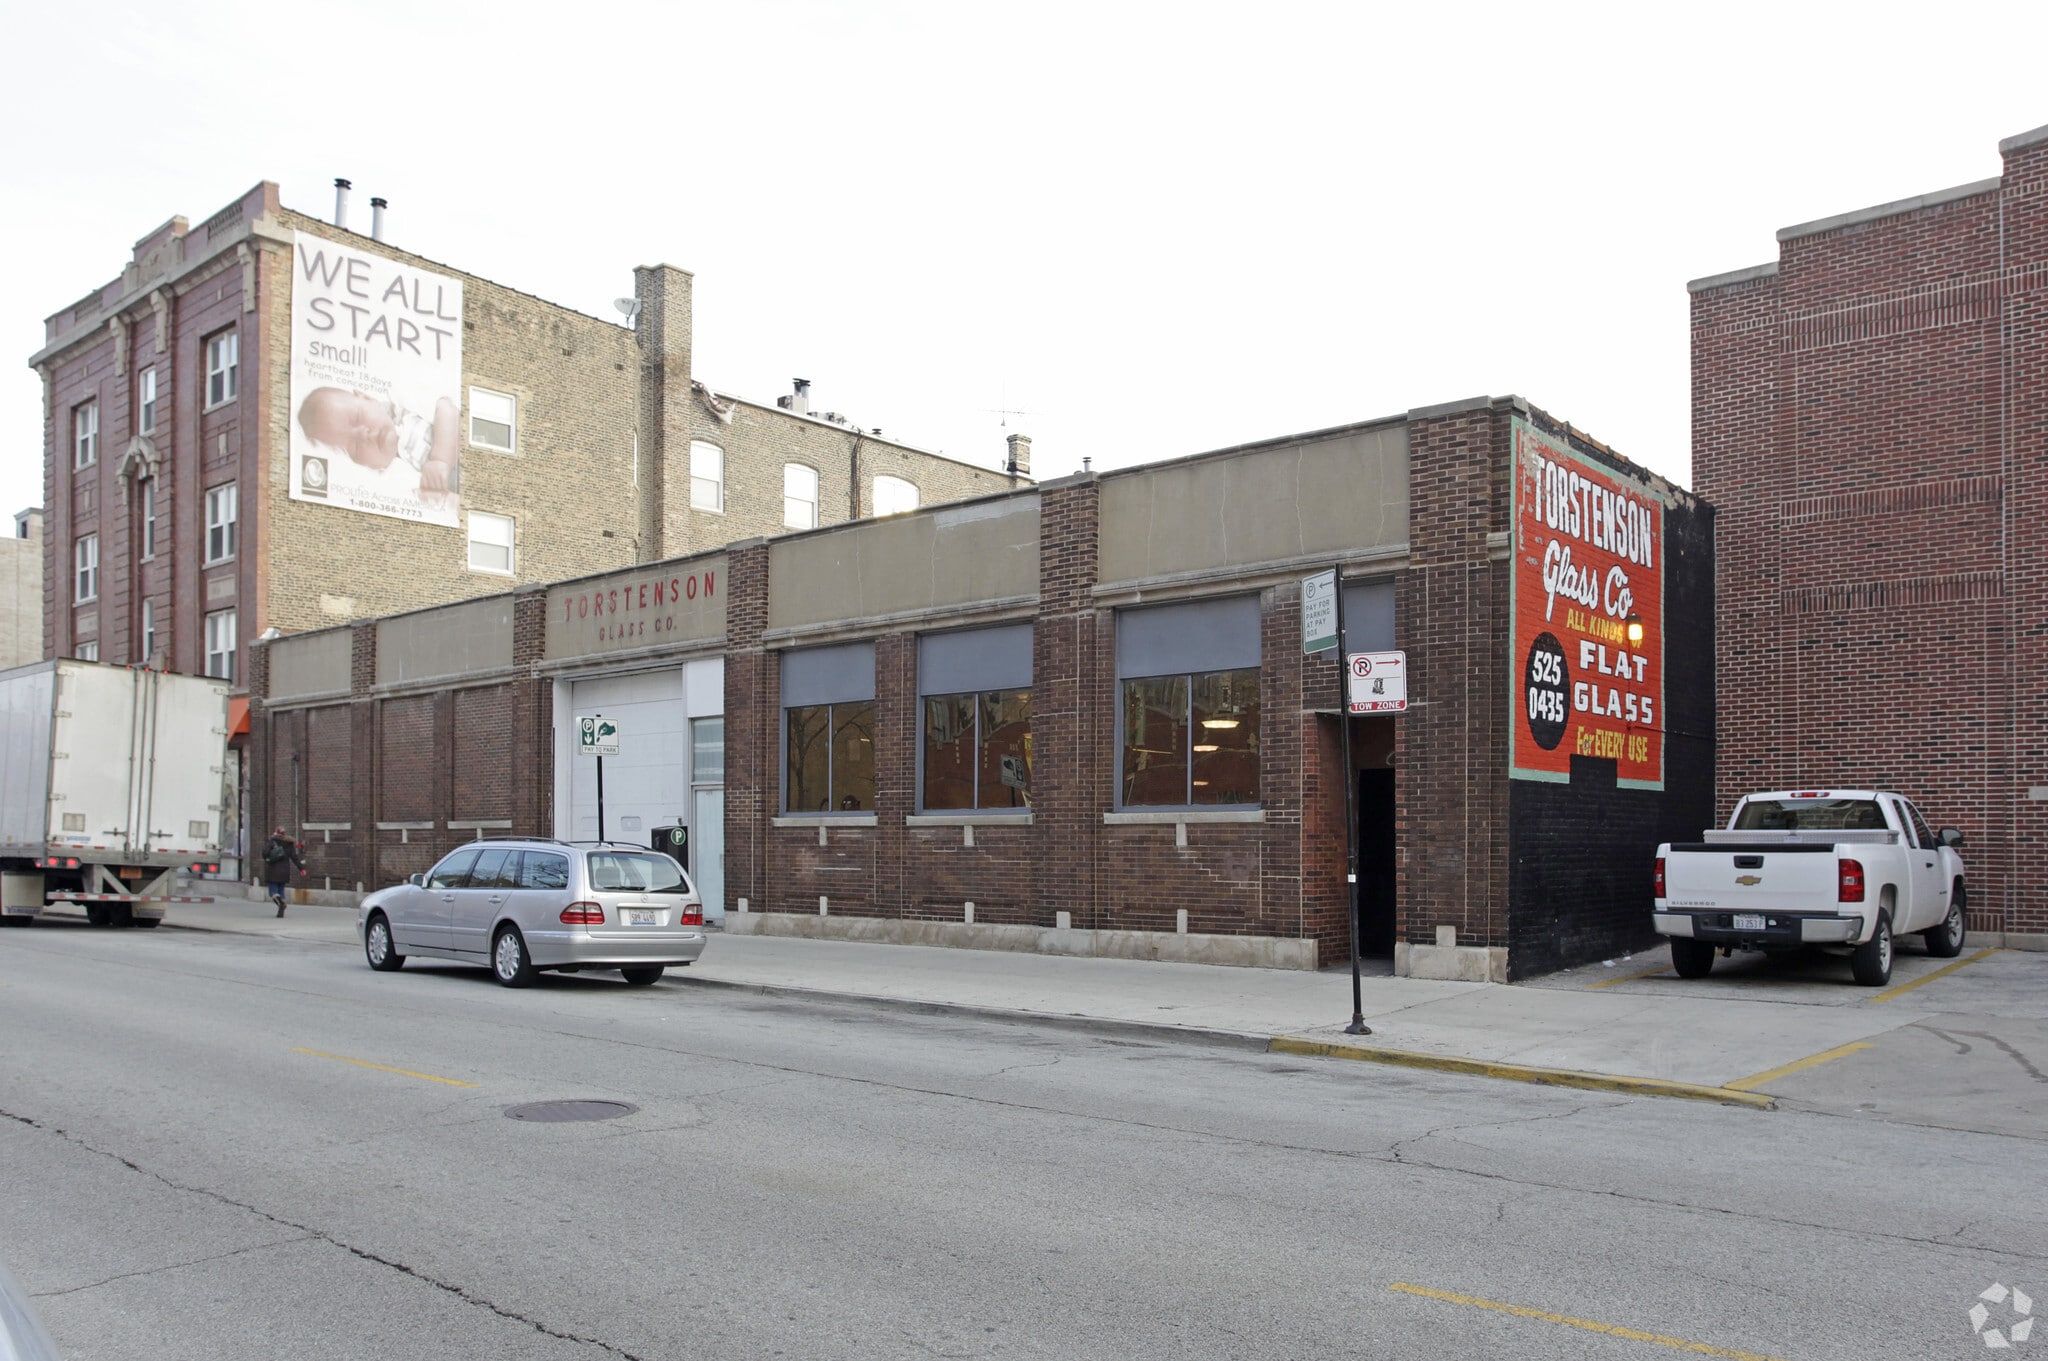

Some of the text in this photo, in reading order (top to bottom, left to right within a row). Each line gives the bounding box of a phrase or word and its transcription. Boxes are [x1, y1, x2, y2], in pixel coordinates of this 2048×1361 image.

[298, 242, 458, 321] WE ALL
[306, 297, 454, 361] START
[308, 340, 367, 369] small!
[304, 358, 355, 378] heartbeat
[370, 376, 393, 388] days
[308, 367, 389, 394] from conception
[350, 498, 423, 518] 1-800-366-7773
[1532, 453, 1653, 569] TORSTENSON
[564, 571, 715, 622] TORSTENSON
[1543, 539, 1599, 624] Glass
[1306, 607, 1331, 619] PARKING
[1319, 599, 1330, 608] FOR
[599, 616, 677, 641] GLASS CO.
[1306, 618, 1326, 628] AT PAY
[1306, 628, 1318, 637] BOX
[1566, 608, 1586, 632] ALL
[1589, 615, 1624, 645] KINDS
[1532, 650, 1562, 686] 525
[1579, 639, 1648, 682] FLAT
[1354, 700, 1401, 711] TOW ZONE
[1529, 686, 1564, 722] 0435
[1574, 681, 1653, 724] GLASS
[1595, 728, 1626, 759] EVERY
[1628, 735, 1648, 763] USE
